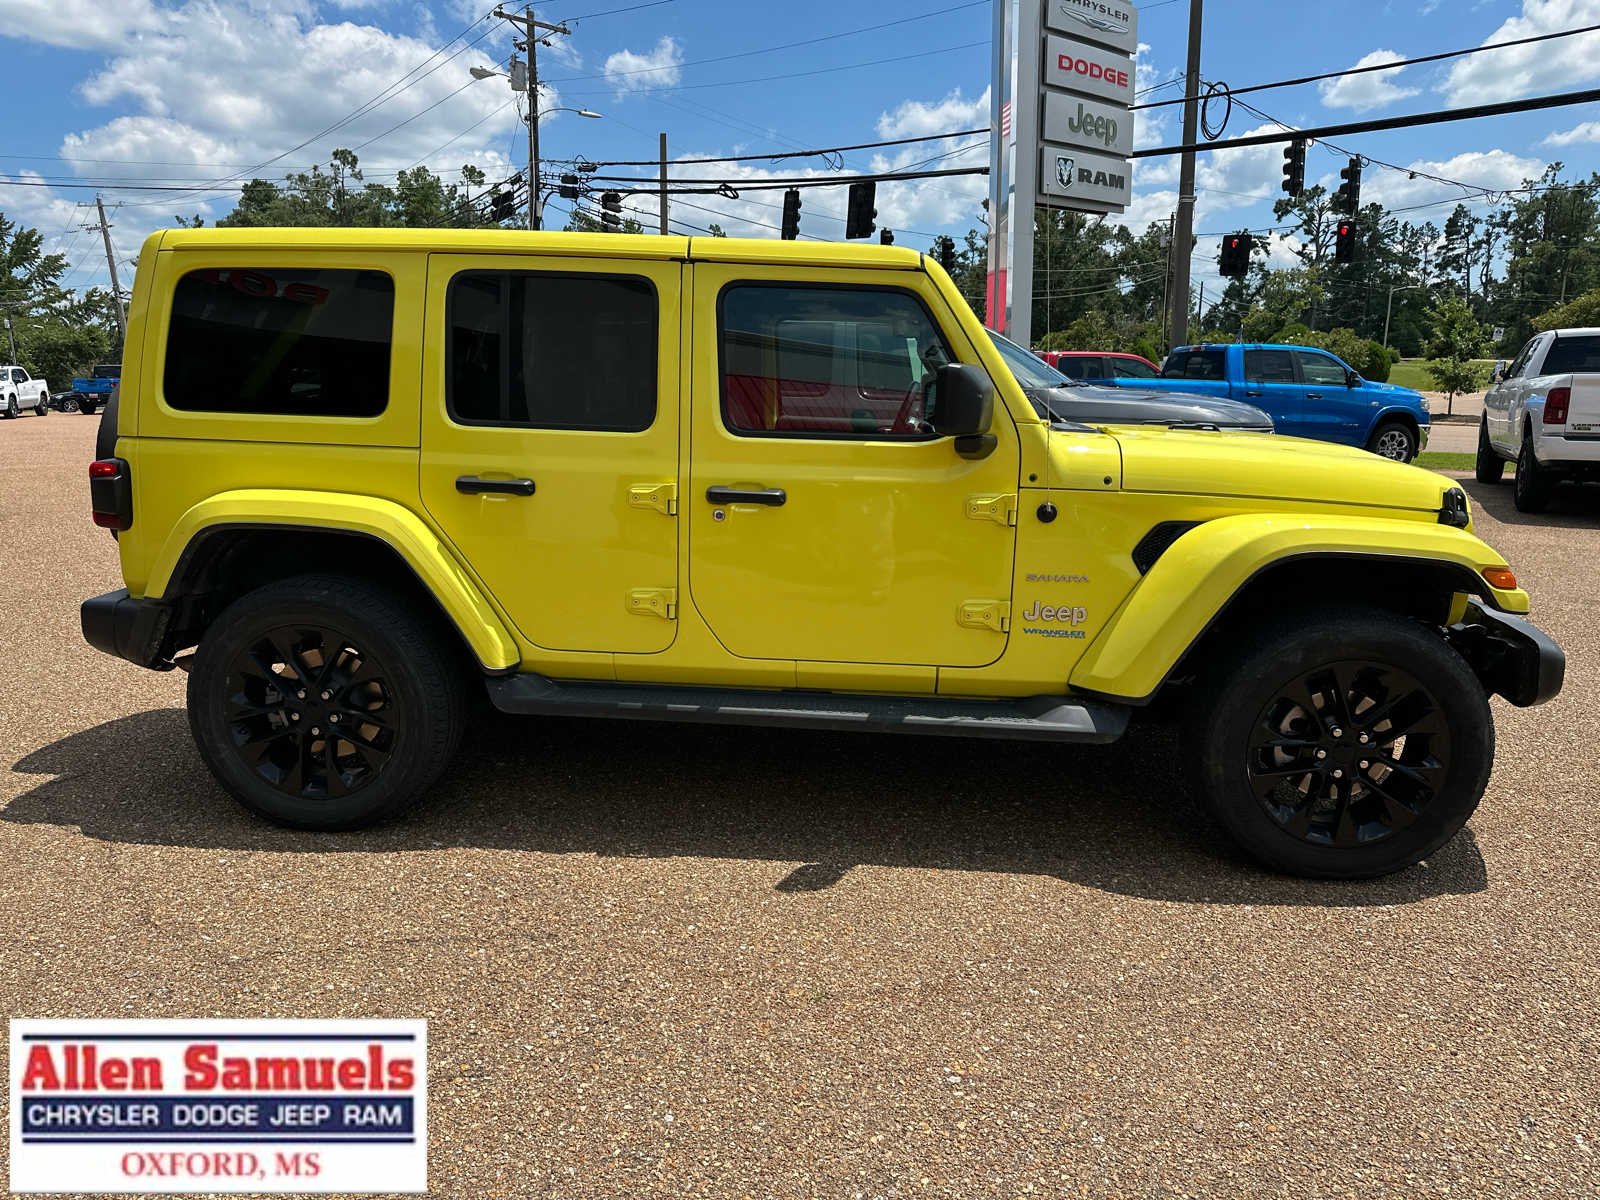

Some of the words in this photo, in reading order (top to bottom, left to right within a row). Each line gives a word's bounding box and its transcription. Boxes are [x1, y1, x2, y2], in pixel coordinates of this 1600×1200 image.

[1065, 0, 1129, 22] HRYSLER
[1058, 54, 1128, 88] DODGE
[1068, 103, 1118, 147] Jeep
[1078, 167, 1125, 189] RAM
[1025, 573, 1089, 583] SAHARA
[1023, 600, 1088, 626] Jeep
[1023, 628, 1086, 638] WRANGLER
